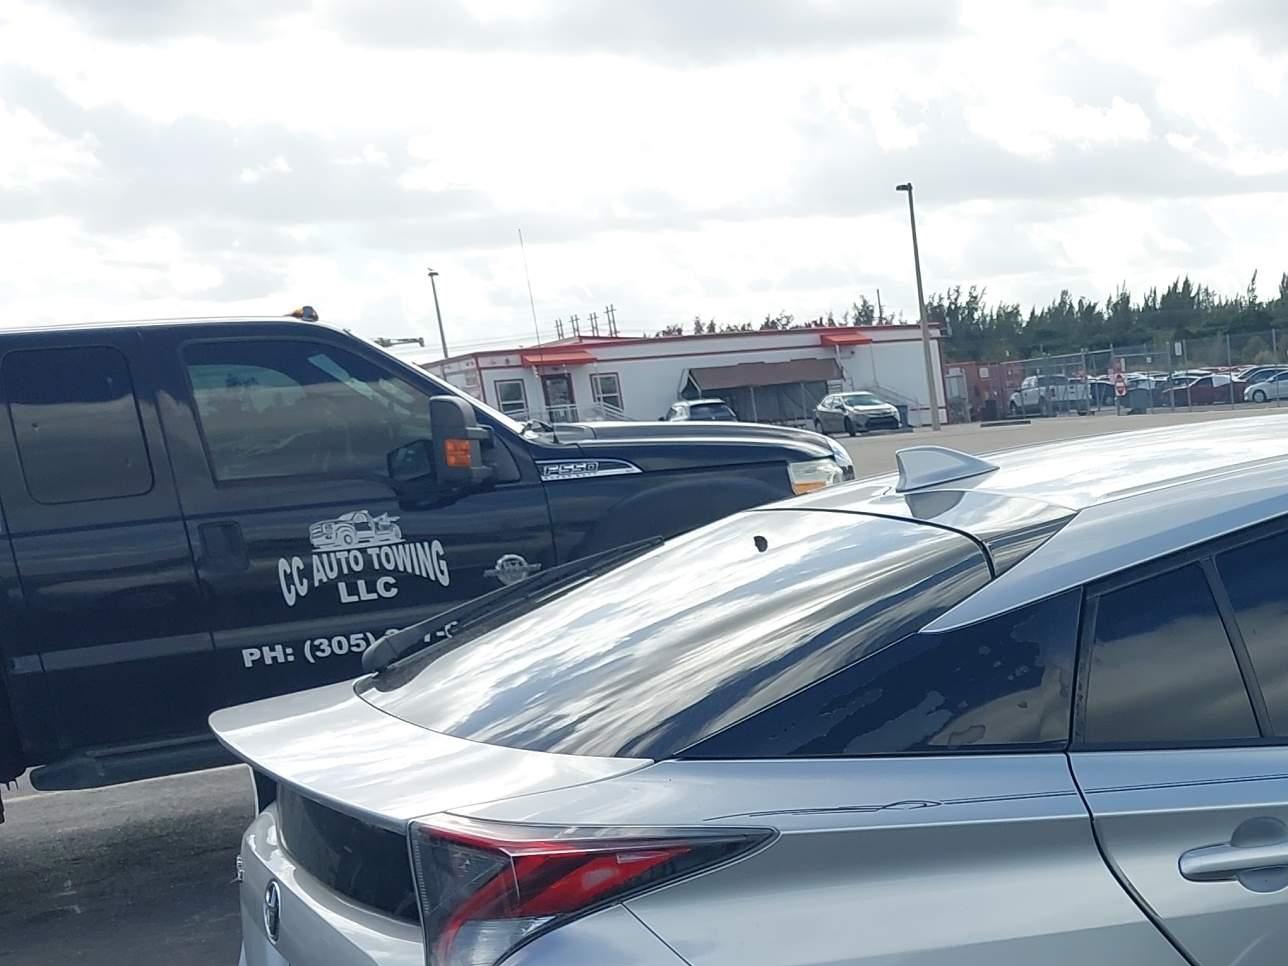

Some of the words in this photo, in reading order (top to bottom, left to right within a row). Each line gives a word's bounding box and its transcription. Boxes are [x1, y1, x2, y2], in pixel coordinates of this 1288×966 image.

[278, 557, 308, 607] CC
[312, 549, 364, 587] AUTO
[368, 539, 450, 587] TOWING
[337, 576, 399, 603] LLC
[241, 644, 295, 668] PH:
